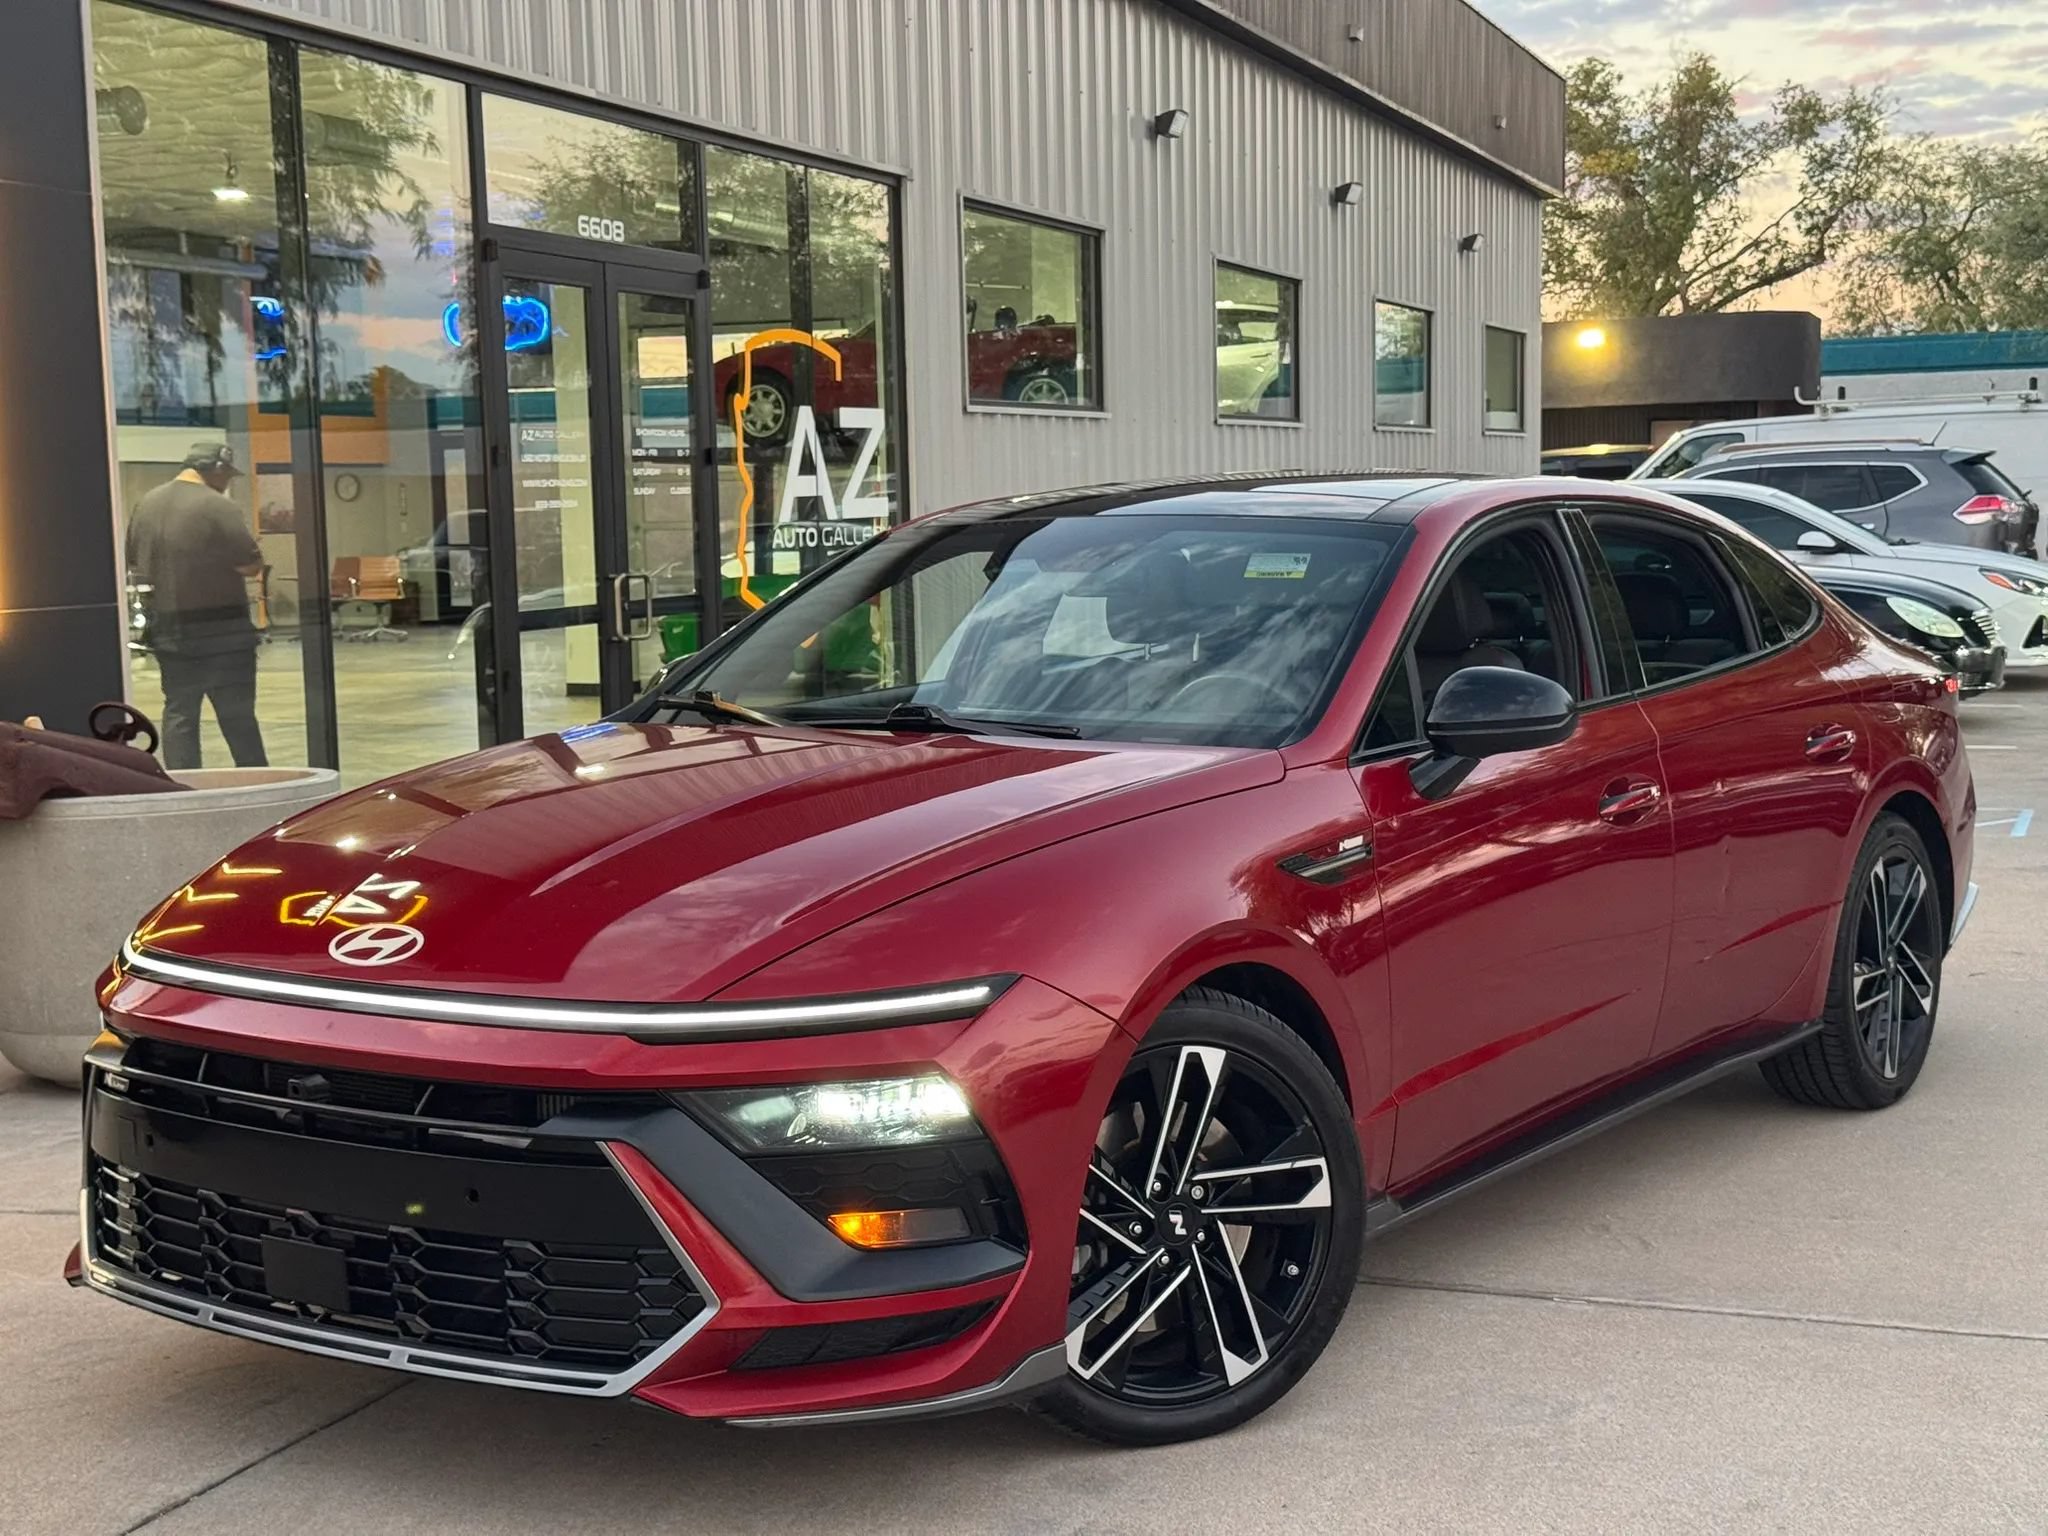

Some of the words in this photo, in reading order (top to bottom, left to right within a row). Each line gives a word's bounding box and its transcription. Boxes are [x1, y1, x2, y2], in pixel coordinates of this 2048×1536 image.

[577, 214, 625, 243] 6608
[778, 404, 889, 523] AZ
[772, 527, 818, 549] AUTO
[821, 525, 890, 547] GALLE
